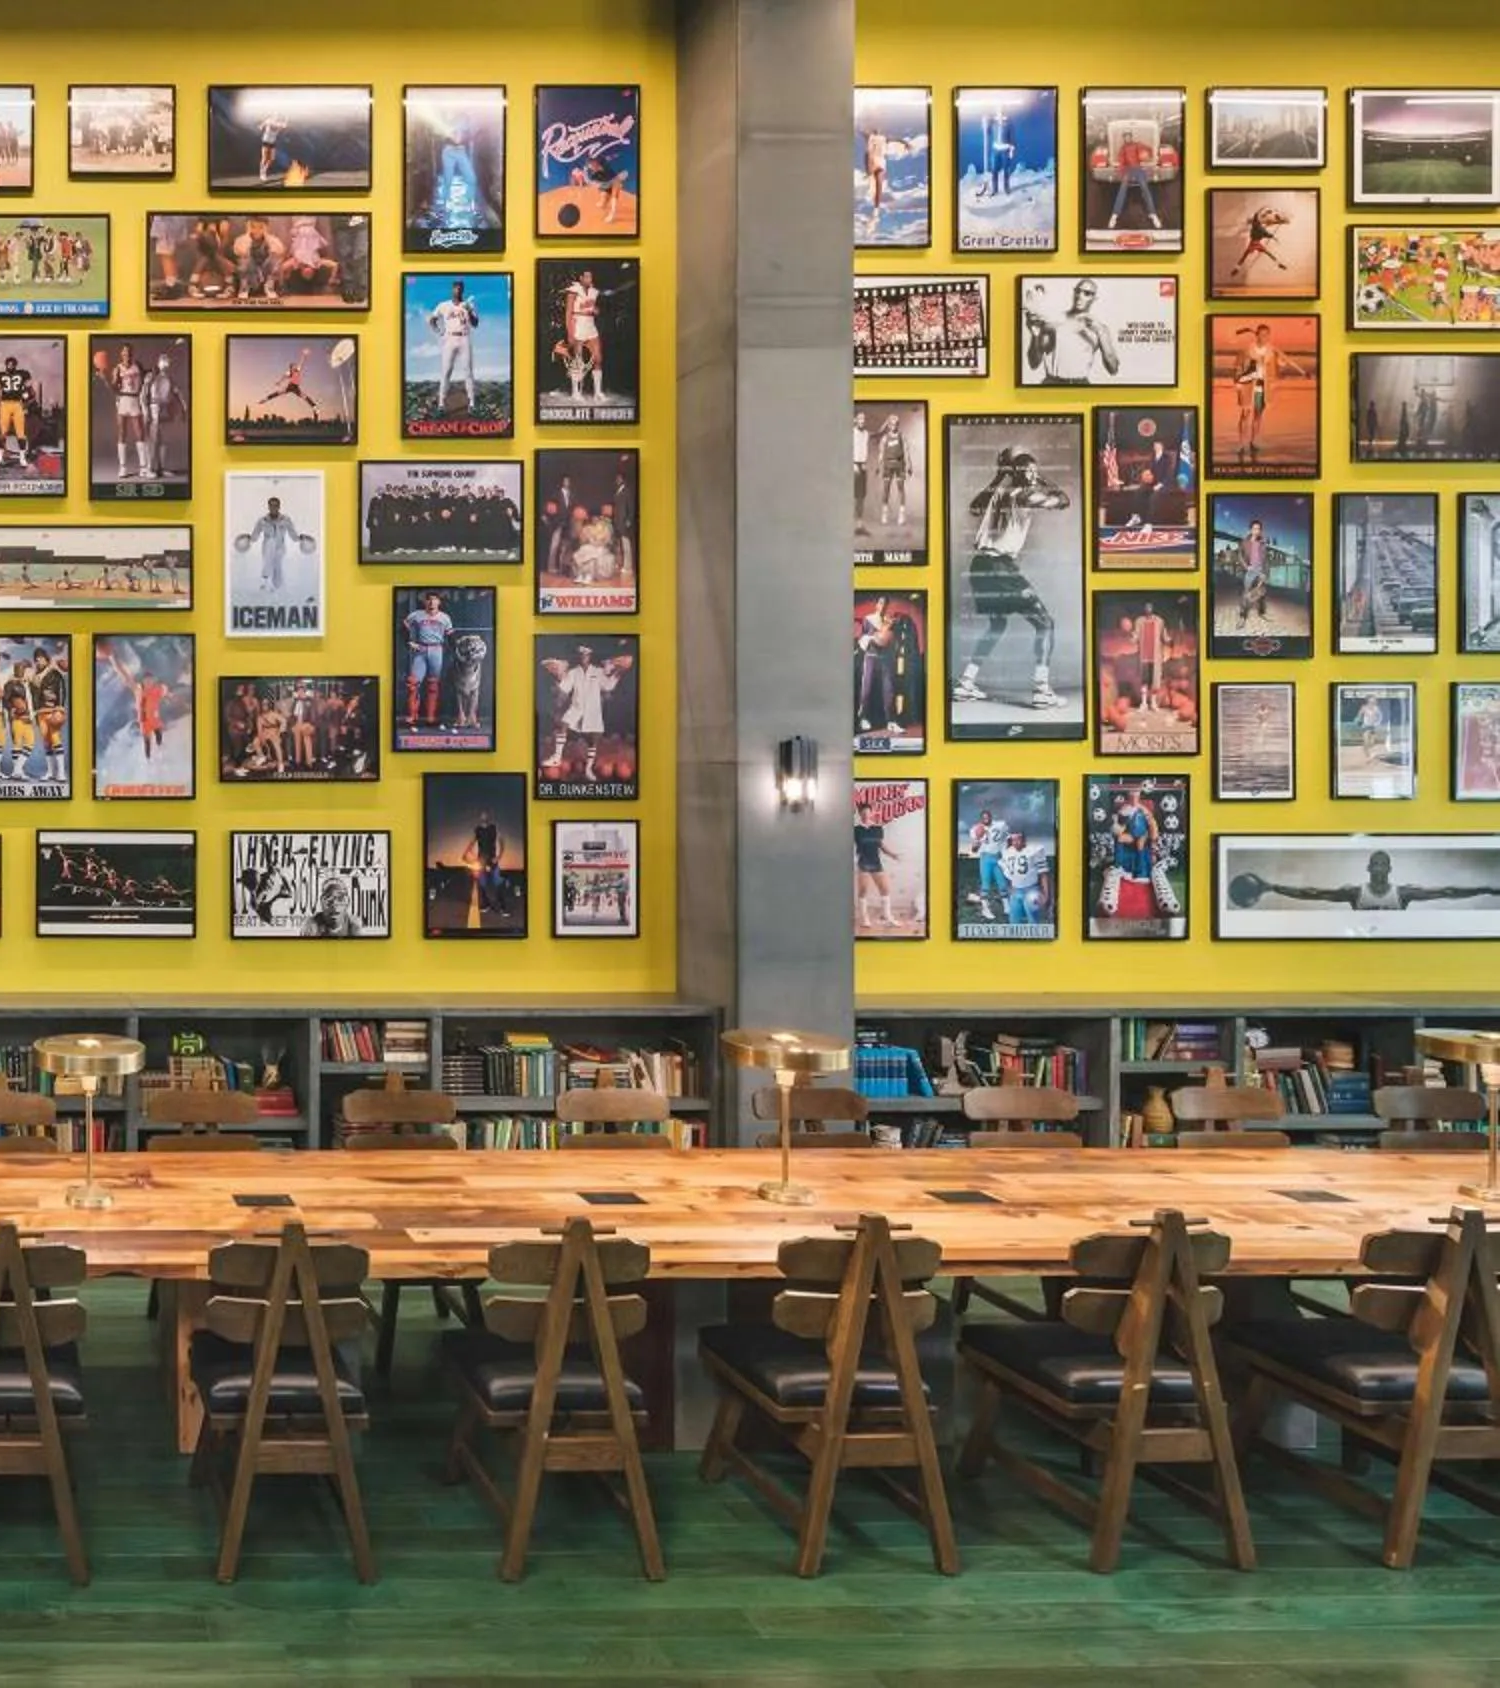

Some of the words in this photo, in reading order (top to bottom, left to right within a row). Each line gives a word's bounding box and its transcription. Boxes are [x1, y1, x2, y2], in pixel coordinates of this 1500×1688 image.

[1, 375, 23, 391] 32
[1114, 530, 1188, 546] NIKE
[555, 595, 634, 609] WILLIAMS
[232, 606, 319, 629] ICEMAN
[1117, 734, 1182, 751] MOSES
[30, 784, 66, 797] AWAY
[963, 925, 998, 938] TEXAS
